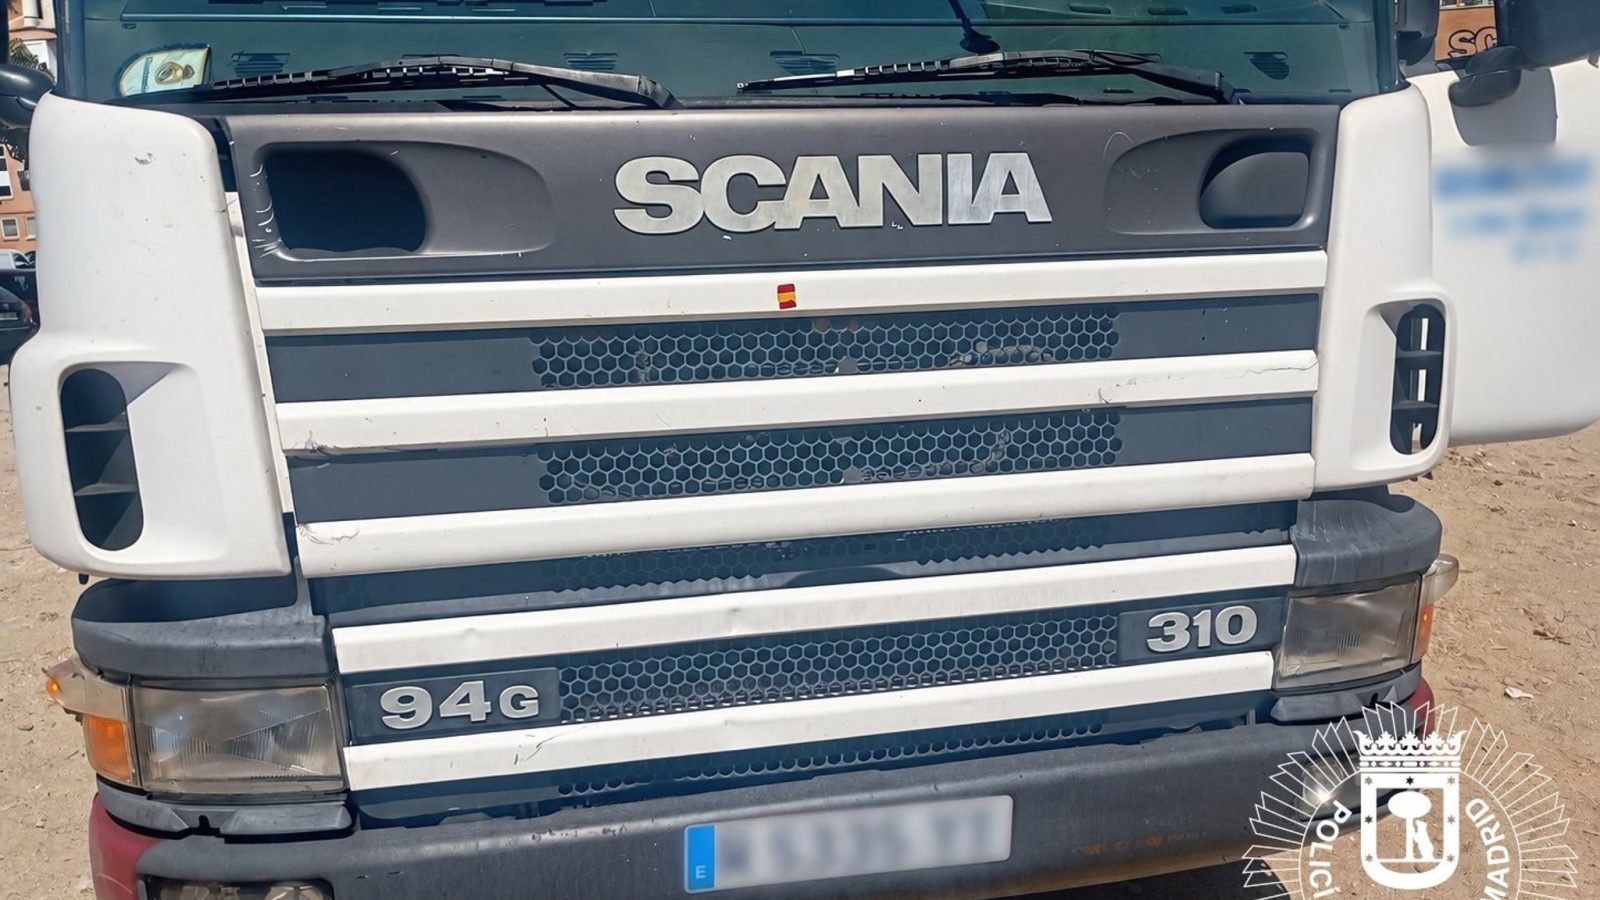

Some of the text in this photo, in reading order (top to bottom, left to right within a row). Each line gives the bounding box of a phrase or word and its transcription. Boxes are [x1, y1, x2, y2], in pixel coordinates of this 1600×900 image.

[614, 152, 1053, 234] SCANIA
[1146, 605, 1257, 652] 310
[695, 864, 707, 880] E
